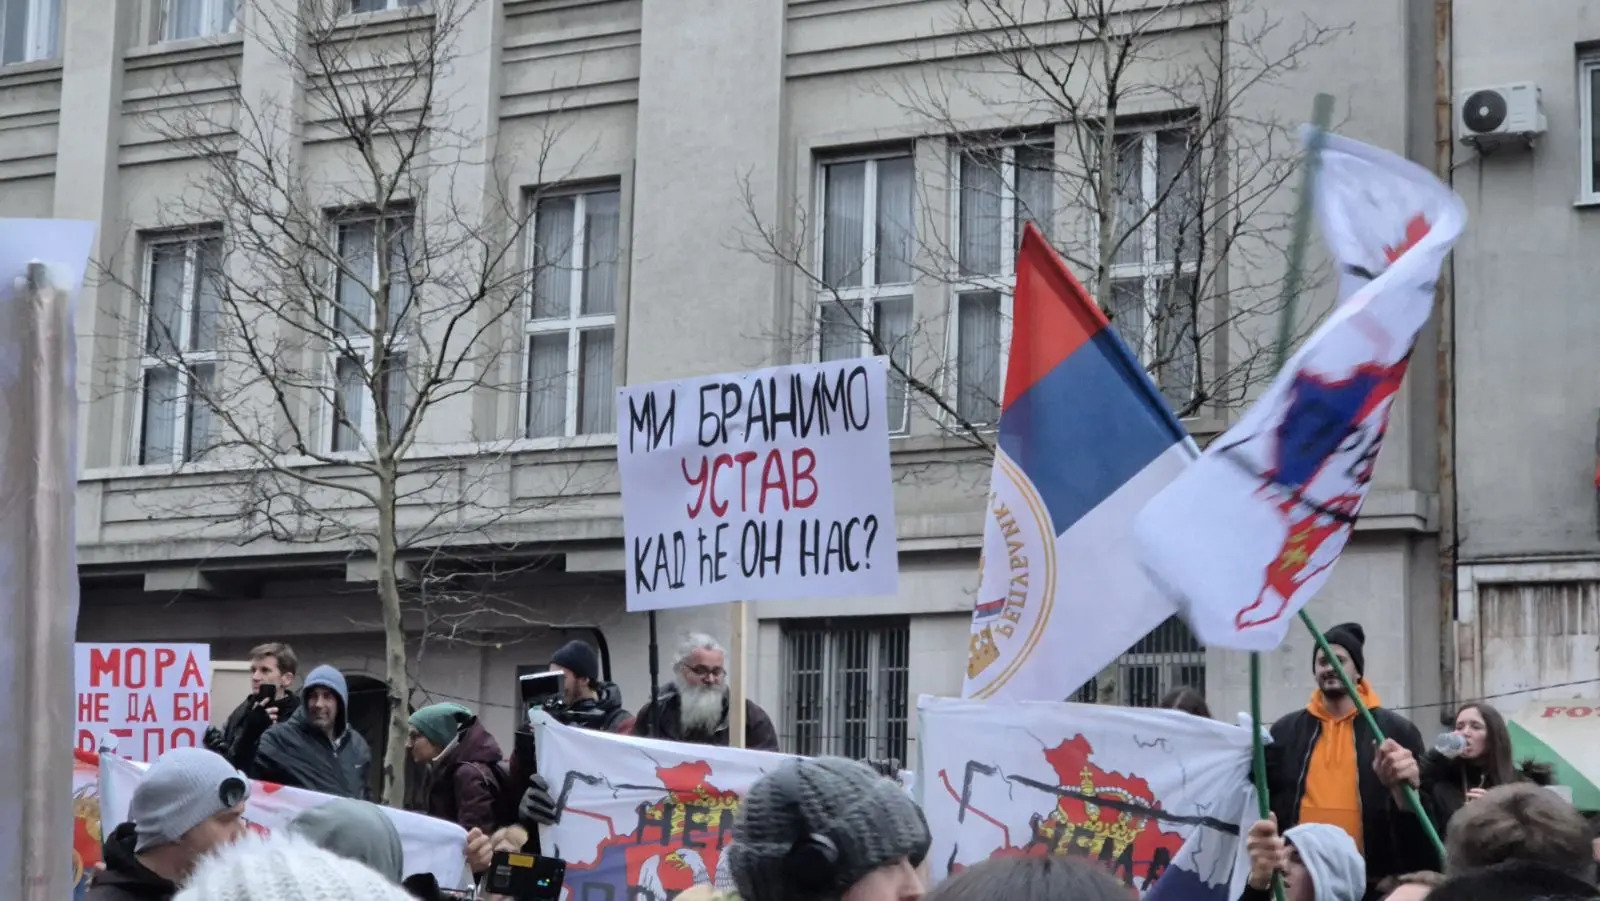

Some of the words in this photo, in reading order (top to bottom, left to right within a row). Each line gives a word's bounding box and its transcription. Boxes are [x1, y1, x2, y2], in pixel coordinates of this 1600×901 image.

[628, 389, 676, 454] МИ
[698, 365, 870, 448] БРАНИМО
[681, 447, 819, 520] УСТАВ
[634, 530, 686, 594] КАД
[740, 518, 784, 579] ОН
[799, 513, 879, 577] НАС?
[89, 647, 205, 689] МОРА
[78, 692, 110, 723] НЕ
[125, 692, 158, 724] ДА
[172, 692, 209, 722] БИ
[1541, 706, 1600, 718] FO
